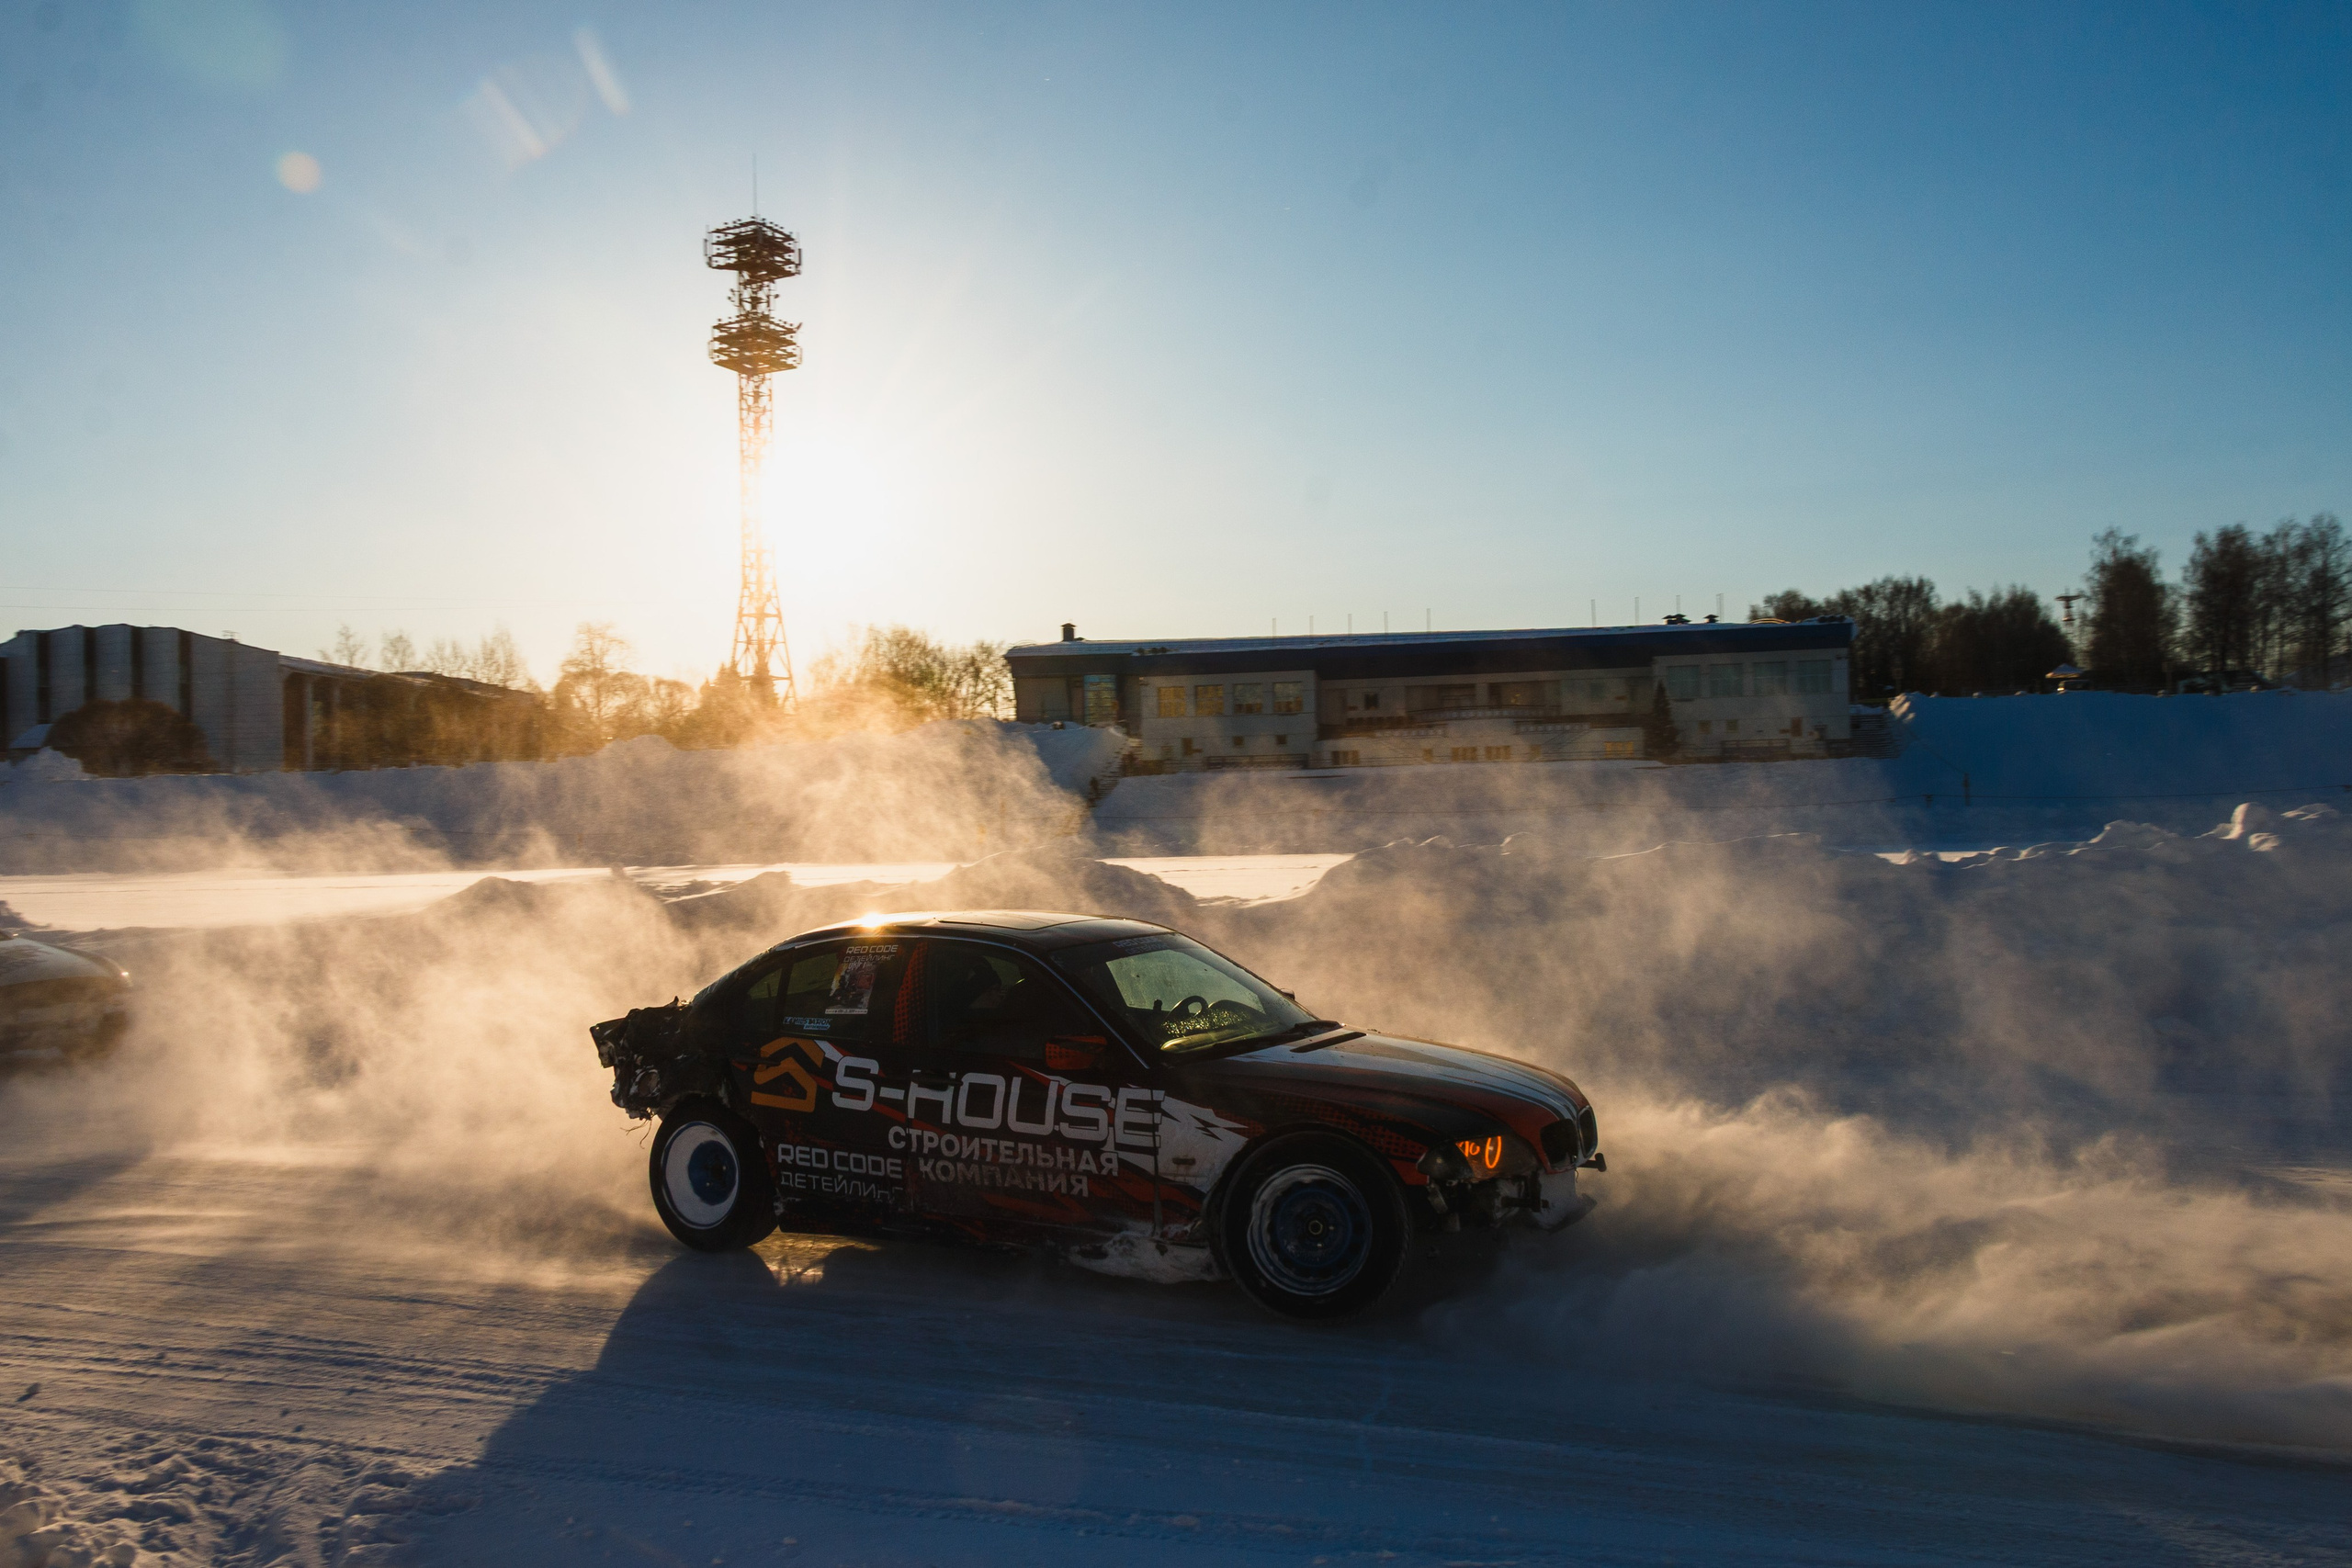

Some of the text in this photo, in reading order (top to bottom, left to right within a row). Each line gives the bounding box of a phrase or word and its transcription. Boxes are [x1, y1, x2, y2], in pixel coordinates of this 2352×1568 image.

[843, 954, 895, 963] ДЕТЕЙЛИНГ
[846, 946, 868, 954] RED
[832, 1056, 1165, 1148] S-HOUSE
[777, 1144, 902, 1179] RED CODE
[888, 1125, 1119, 1177] СТРОИТЕЛЬНАЯ
[919, 1157, 1090, 1198] КОМПАНИЯ
